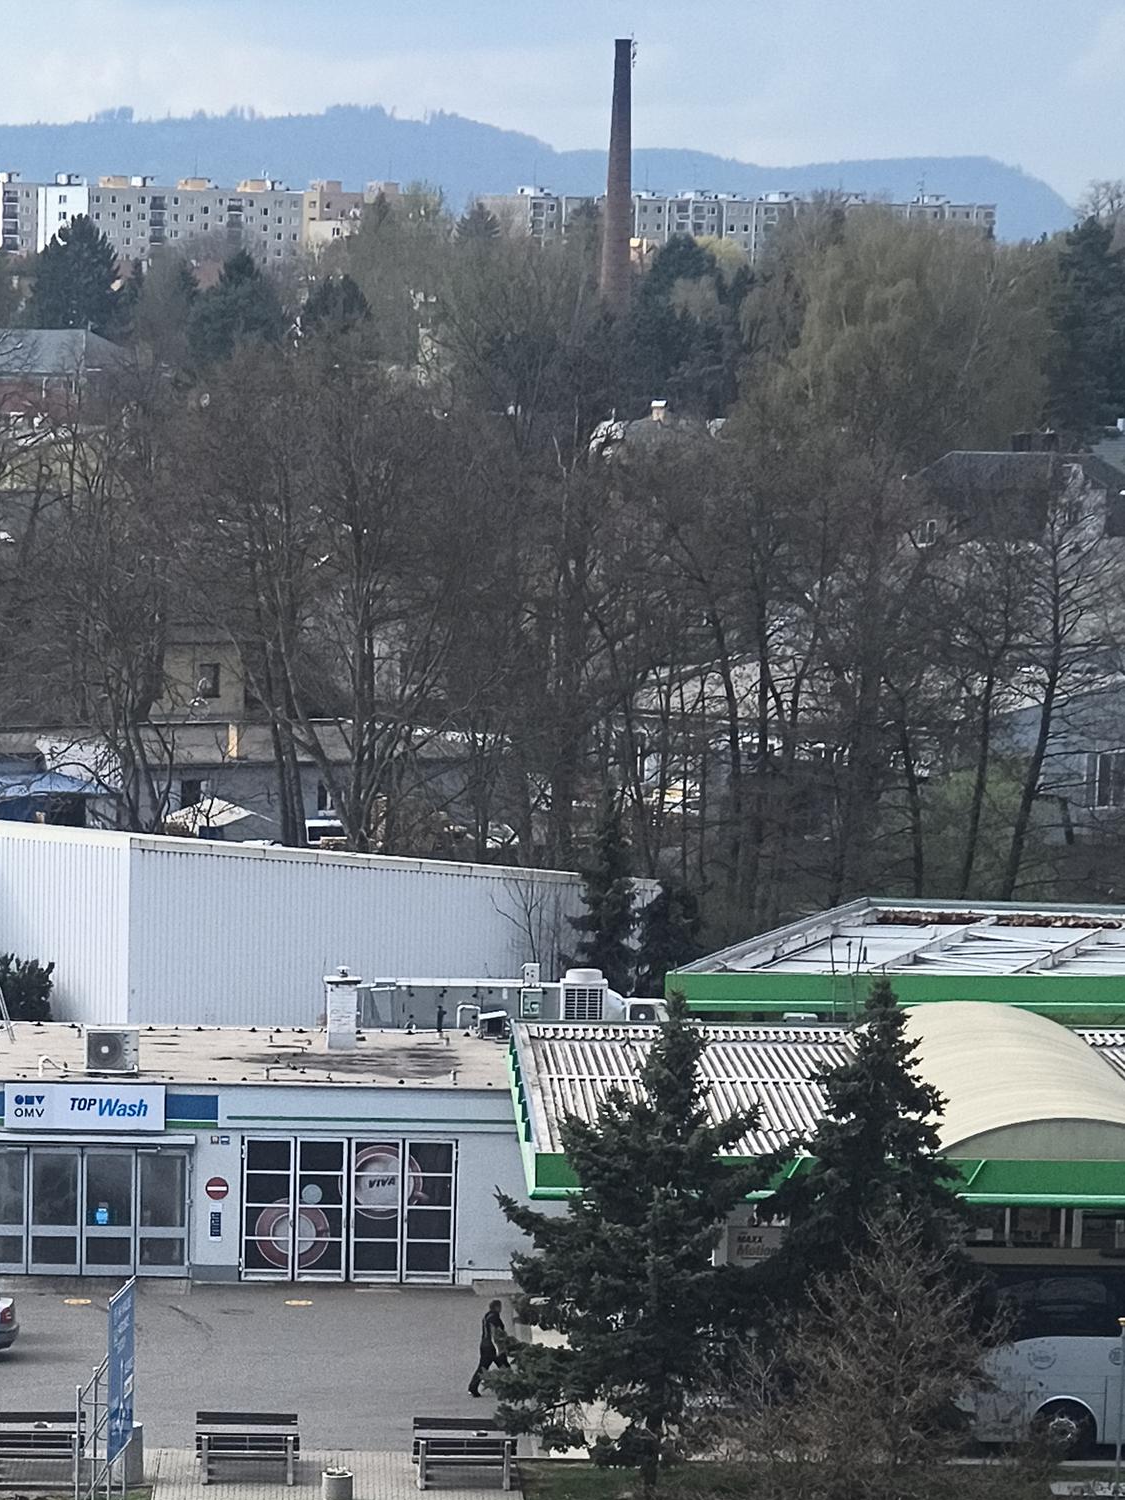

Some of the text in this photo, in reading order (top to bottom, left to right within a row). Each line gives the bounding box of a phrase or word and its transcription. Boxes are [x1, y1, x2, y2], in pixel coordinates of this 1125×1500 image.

[14, 1108, 45, 1117] OMV
[70, 1098, 148, 1117] TOP Wash
[369, 1177, 395, 1188] VIVA
